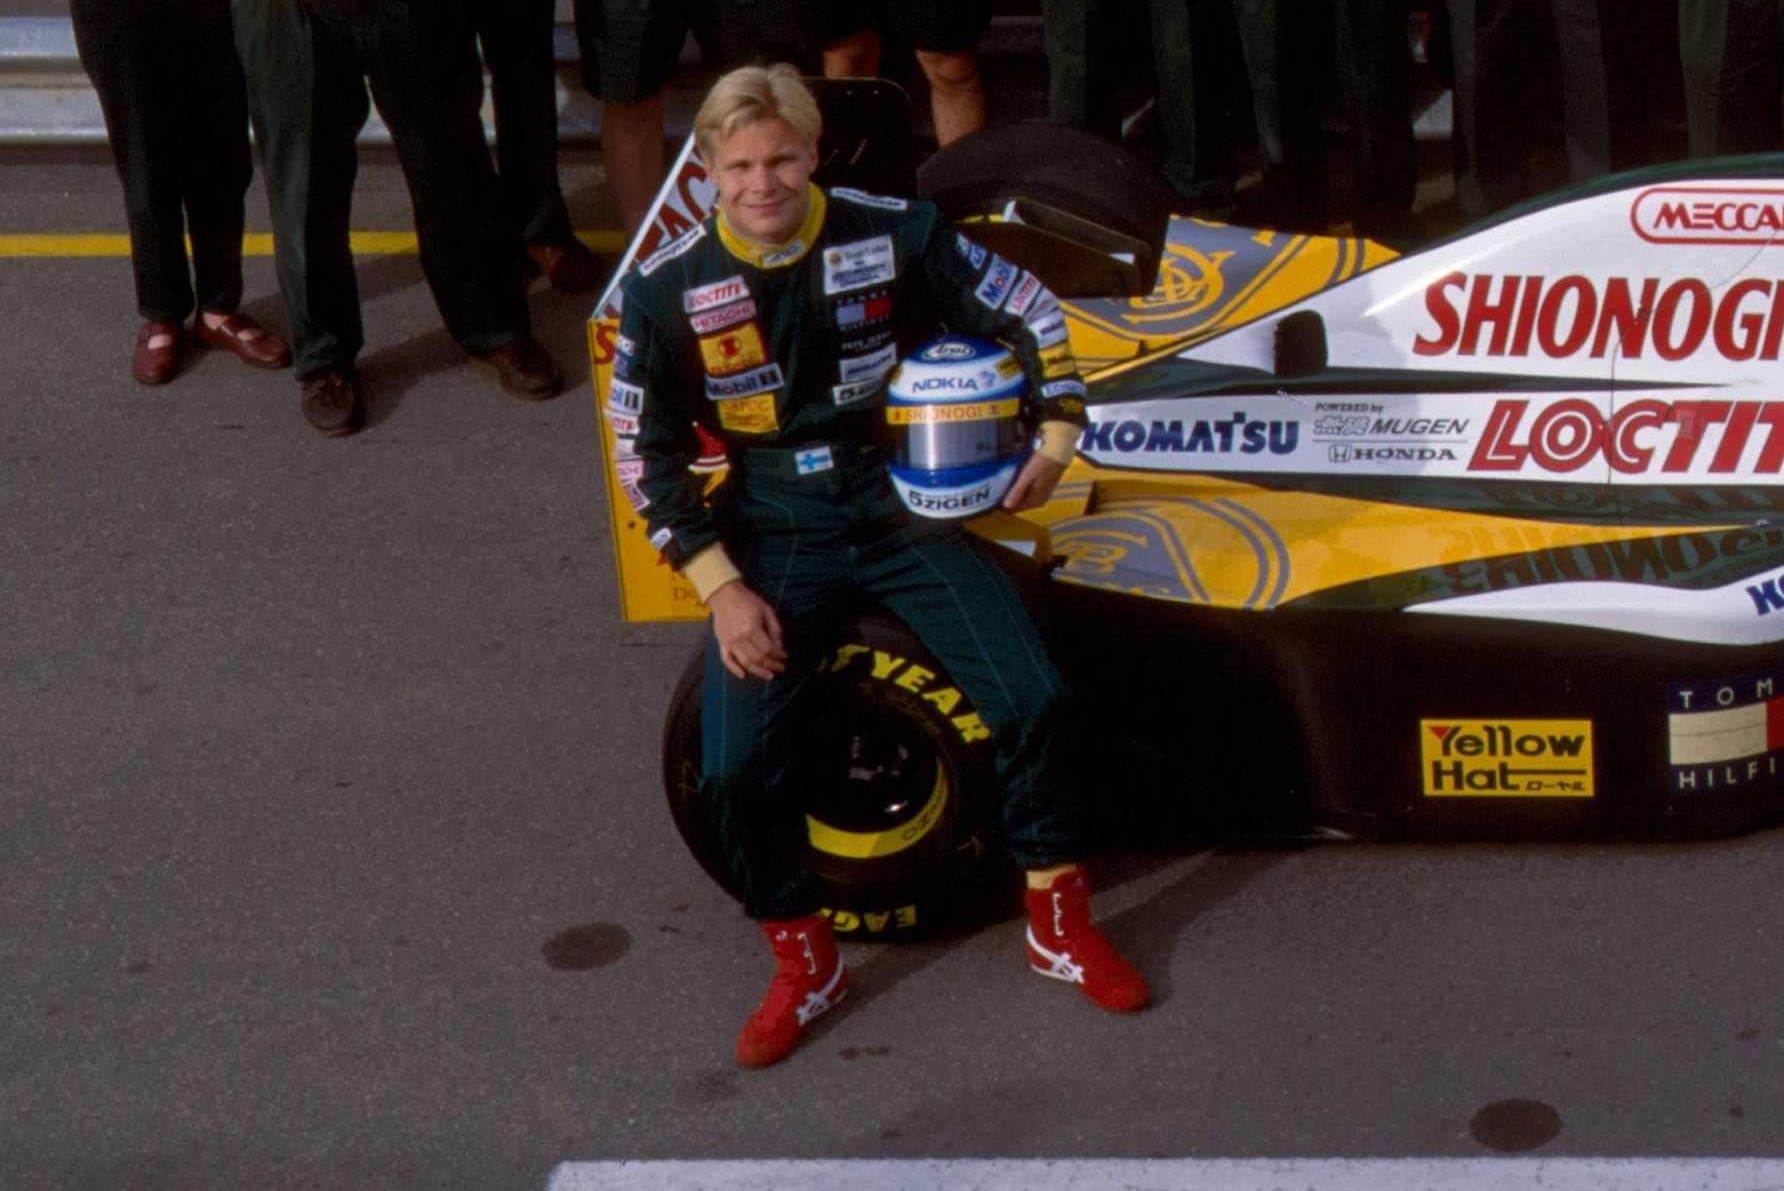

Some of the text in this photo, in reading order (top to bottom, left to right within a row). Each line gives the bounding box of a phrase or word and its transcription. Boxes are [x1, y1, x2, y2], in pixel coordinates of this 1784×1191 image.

[688, 282, 742, 308] LOCTITE
[982, 261, 1014, 304] Mob
[694, 305, 751, 331] HITACHI
[707, 377, 757, 397] Mobil
[912, 377, 978, 392] NOKIA
[906, 406, 982, 422] SHIONOGI
[1316, 402, 1369, 412] POWERED
[1080, 411, 1298, 455] KOMATSU
[1370, 418, 1470, 435] MUGEN
[1354, 448, 1457, 460] HONDA
[866, 651, 992, 744] YEAR
[1428, 725, 1585, 756] Yellow
[1432, 761, 1530, 790] Hat
